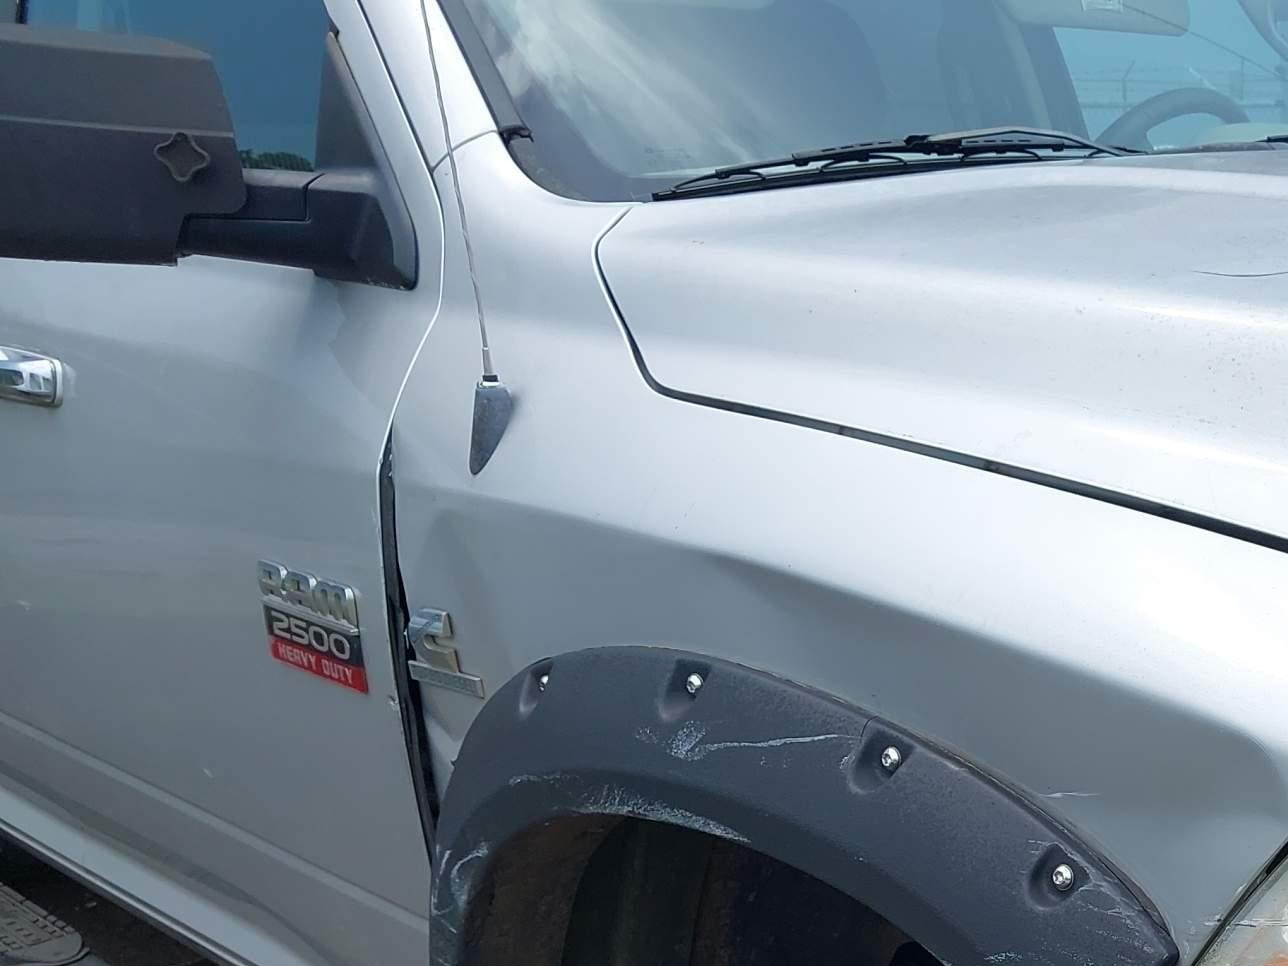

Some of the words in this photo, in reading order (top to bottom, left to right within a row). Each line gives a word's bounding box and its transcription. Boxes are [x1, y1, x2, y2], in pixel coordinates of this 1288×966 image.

[270, 611, 351, 661] 2500
[277, 643, 318, 670] HEAVY
[321, 655, 354, 685] DUTY
